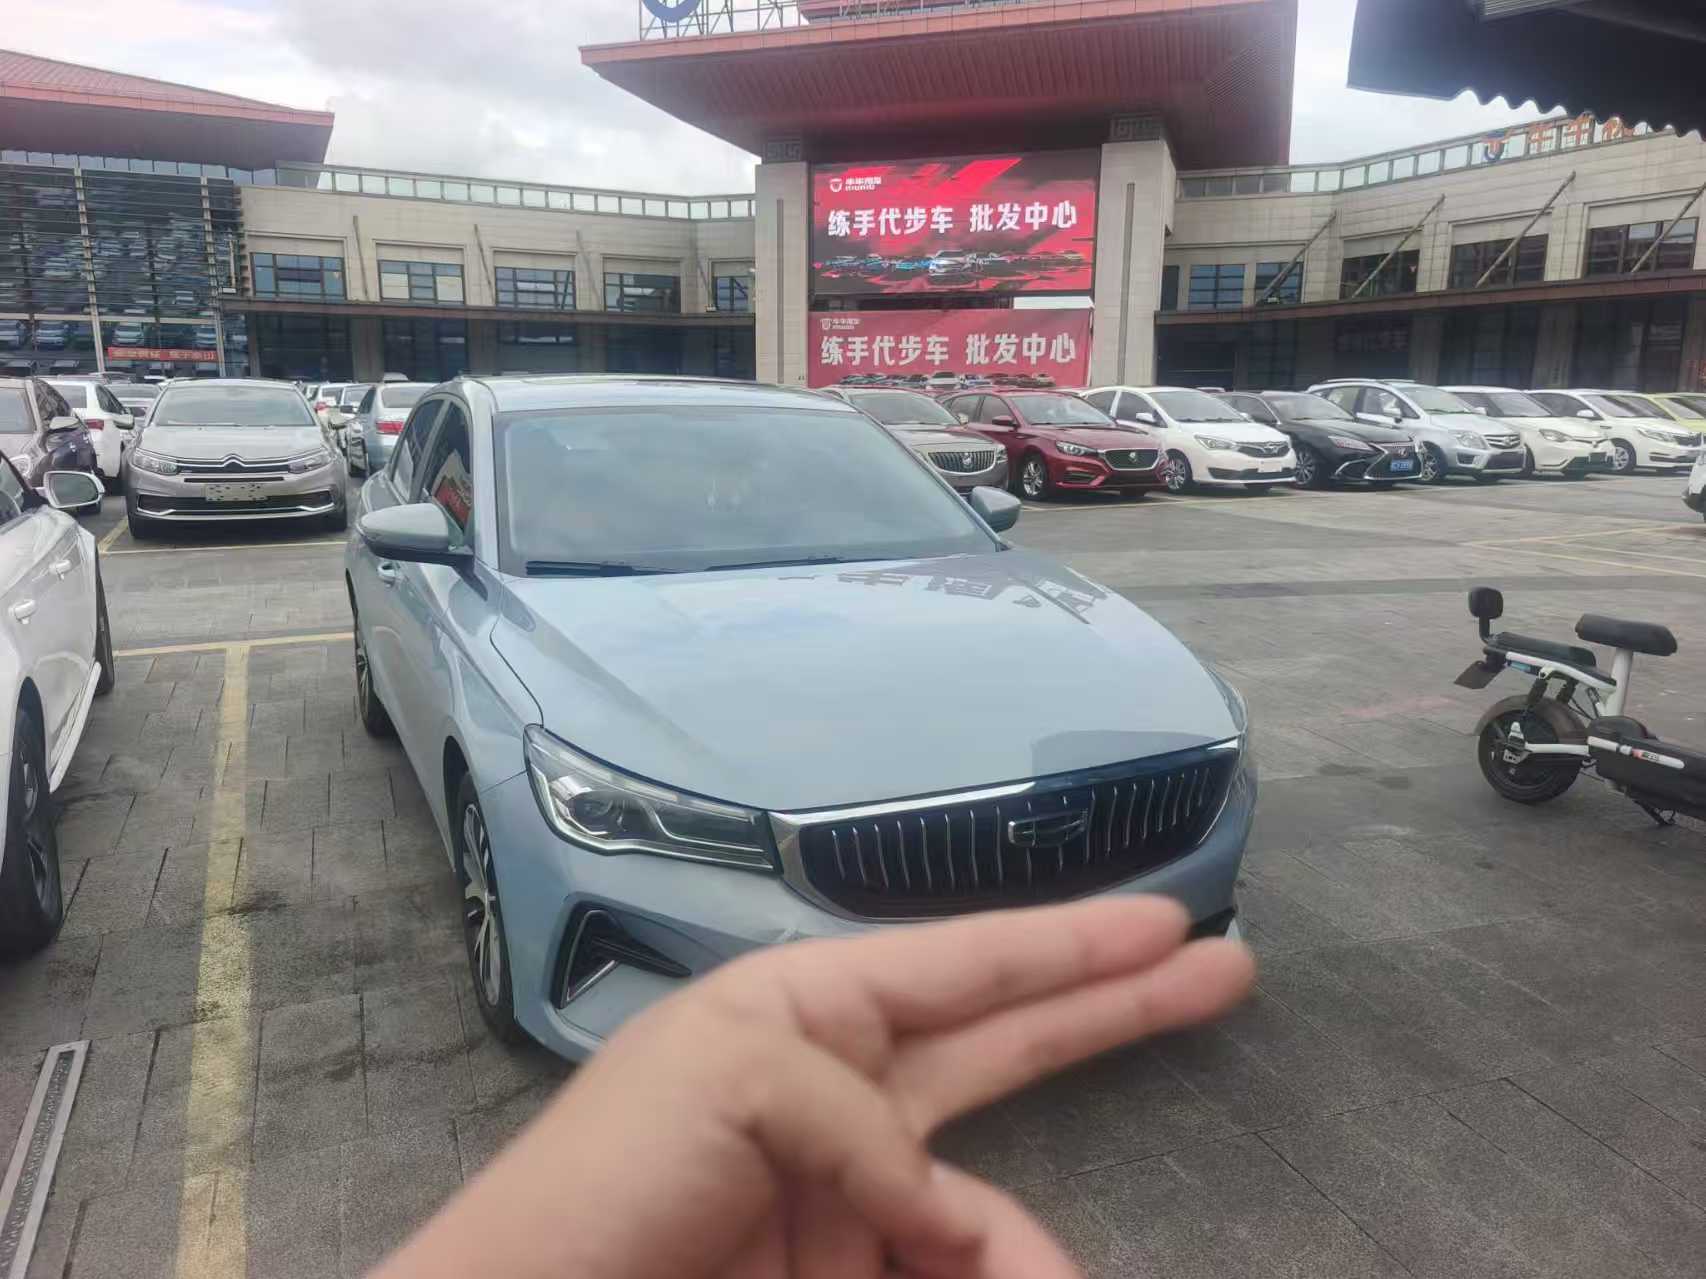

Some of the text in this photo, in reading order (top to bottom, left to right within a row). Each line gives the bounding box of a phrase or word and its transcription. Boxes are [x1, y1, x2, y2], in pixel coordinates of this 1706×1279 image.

[827, 200, 1077, 237] 练手代步车 批发中心
[820, 333, 1076, 366] 练手代步车 批发中心
